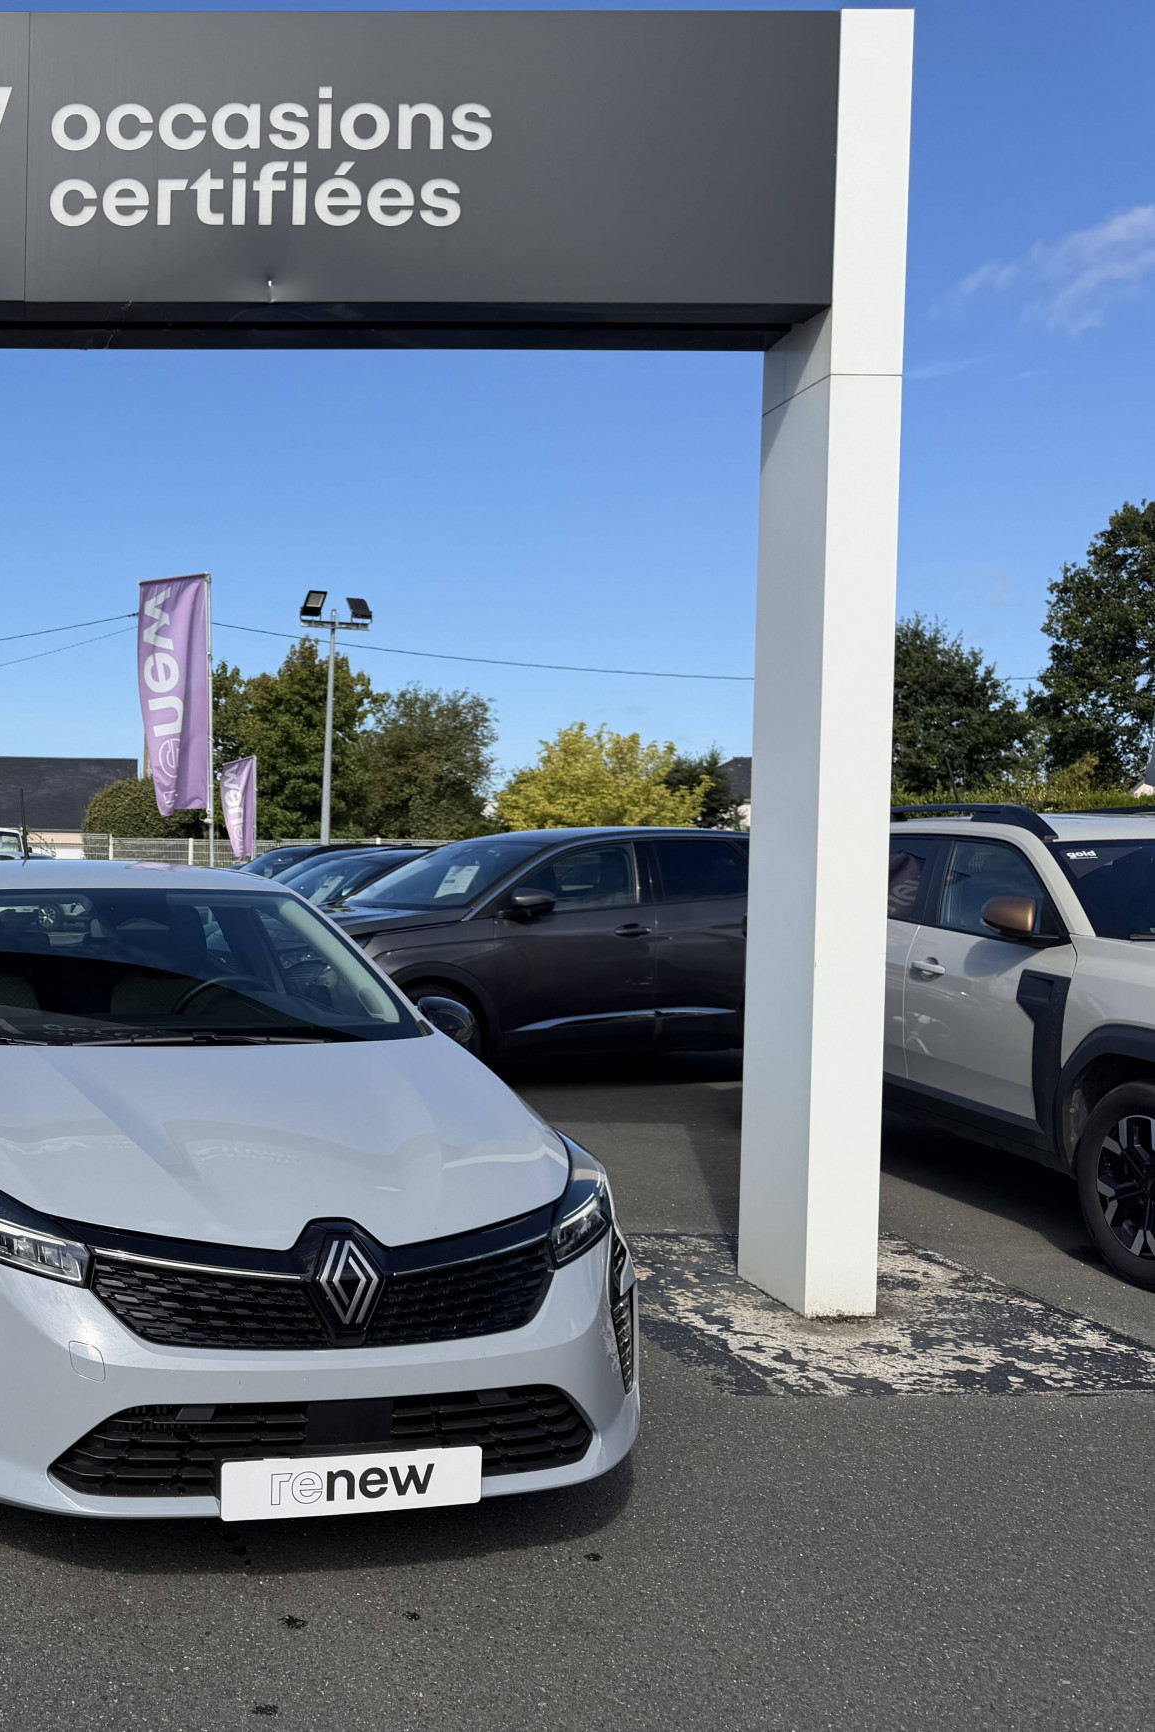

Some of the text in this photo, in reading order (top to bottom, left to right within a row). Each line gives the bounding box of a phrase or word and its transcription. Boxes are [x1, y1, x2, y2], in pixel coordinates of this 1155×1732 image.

[51, 86, 493, 151] occasions
[50, 161, 462, 227] certifiées
[270, 1463, 435, 1506] renew
